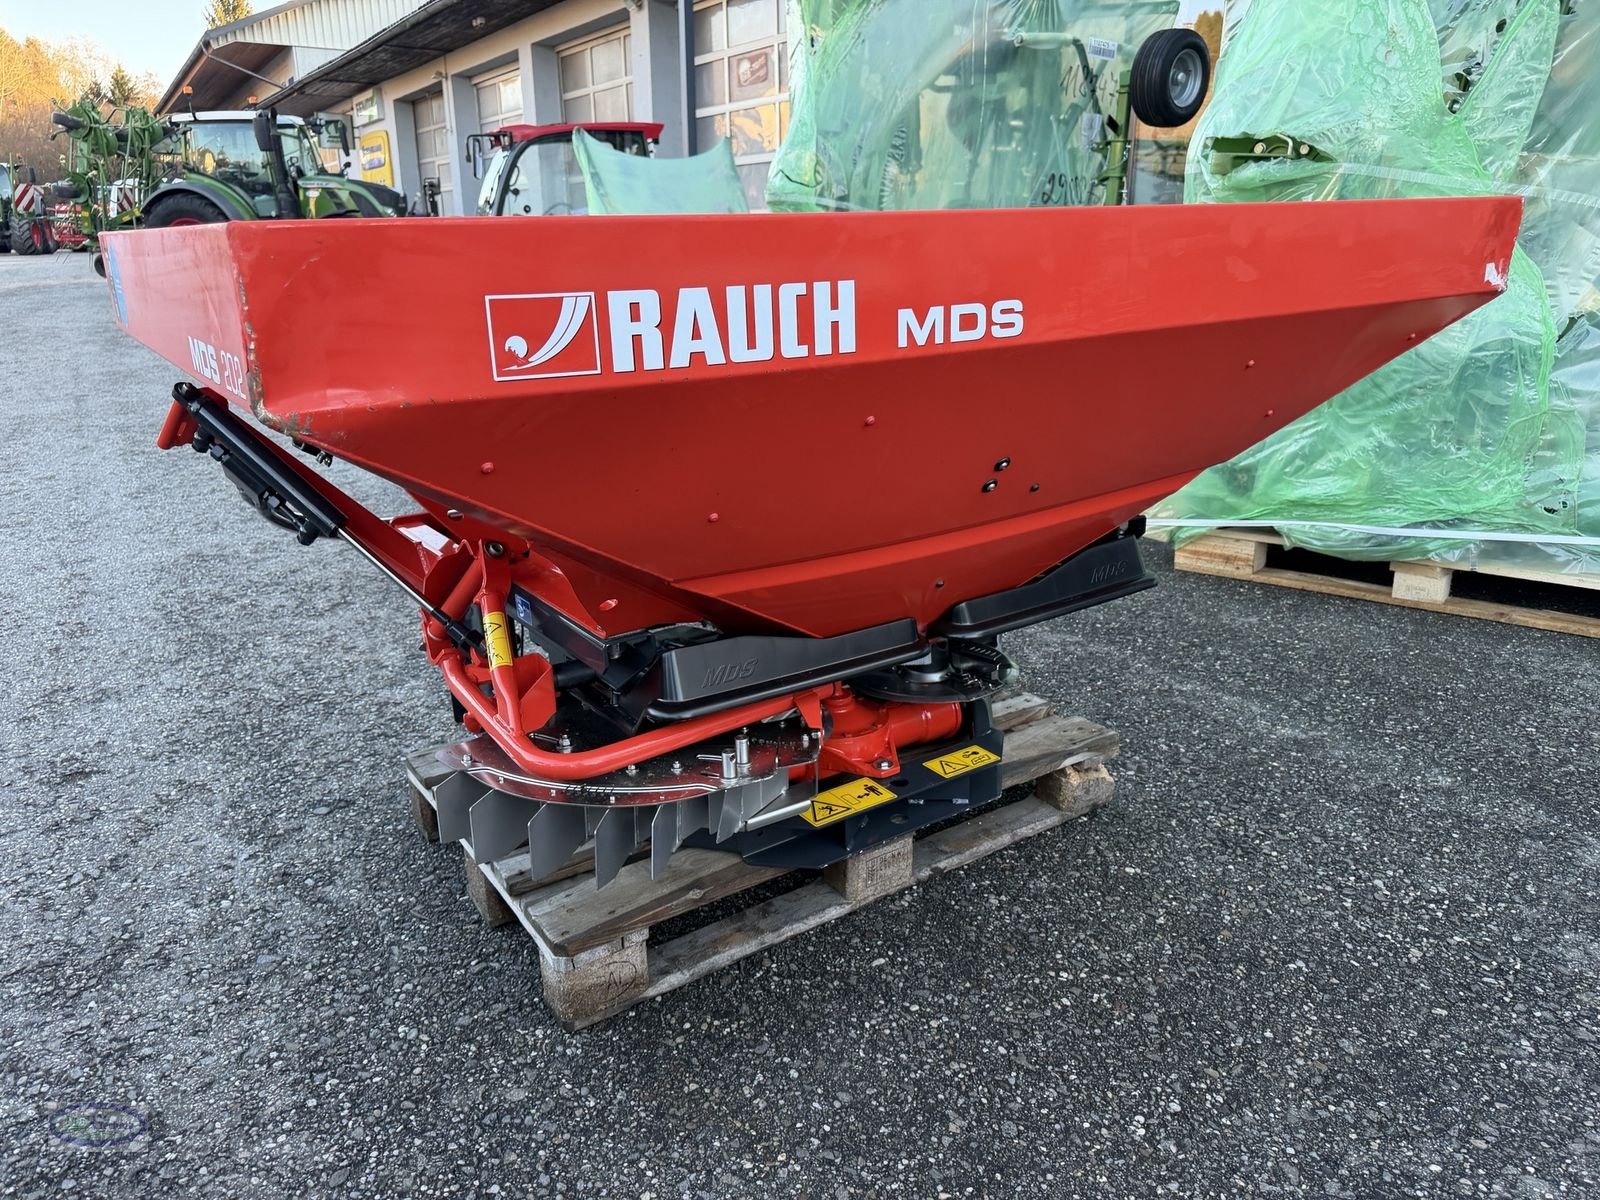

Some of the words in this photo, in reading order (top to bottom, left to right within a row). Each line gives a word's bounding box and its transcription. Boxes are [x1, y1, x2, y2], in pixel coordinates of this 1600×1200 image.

[607, 279, 856, 373] RAUCH
[897, 299, 1024, 348] MDS
[188, 335, 221, 385] MDS
[221, 350, 247, 400] 202
[700, 658, 759, 689] MDS
